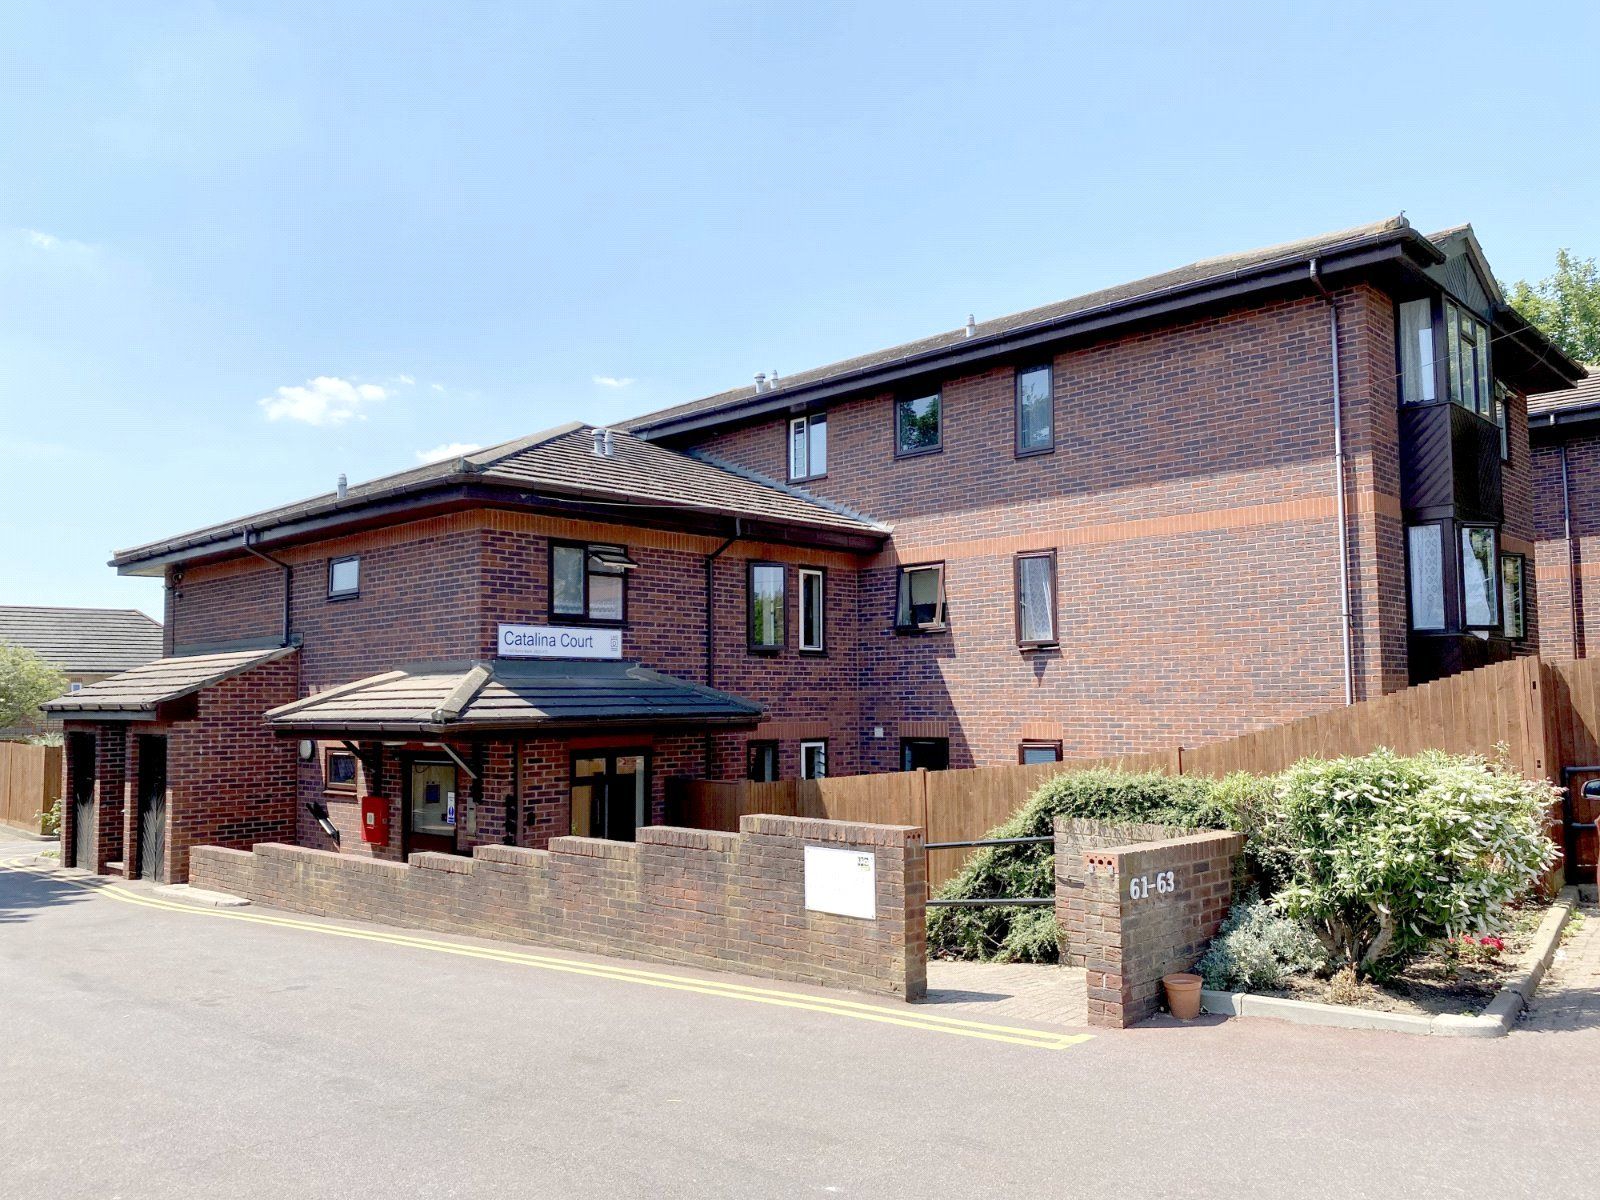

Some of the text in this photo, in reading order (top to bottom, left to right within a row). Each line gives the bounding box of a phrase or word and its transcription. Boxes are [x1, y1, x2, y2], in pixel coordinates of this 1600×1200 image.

[504, 631, 593, 649] Catalina Court
[1130, 871, 1174, 899] 61-63
